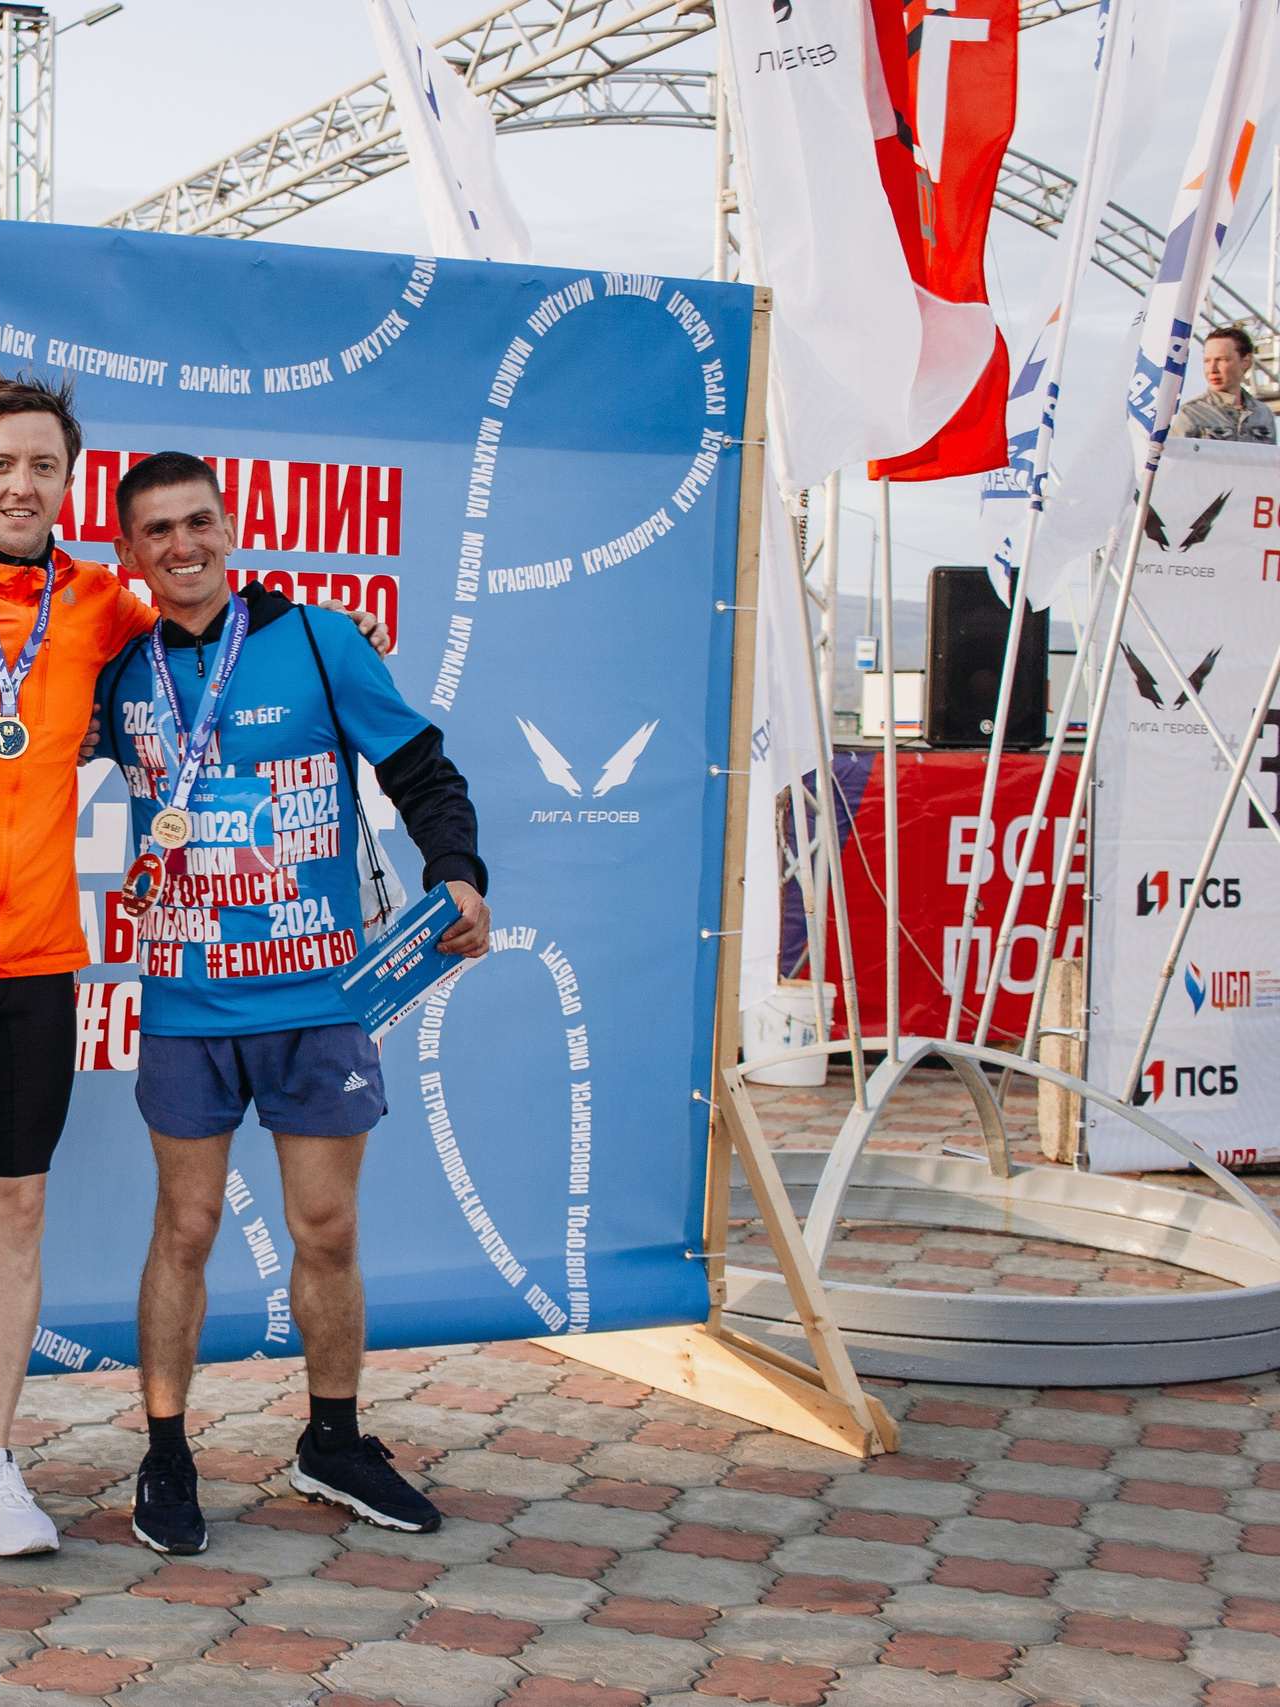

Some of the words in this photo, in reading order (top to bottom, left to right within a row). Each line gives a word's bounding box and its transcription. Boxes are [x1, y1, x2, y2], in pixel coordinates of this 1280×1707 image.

[526, 277, 595, 337] МАГАДАН
[602, 272, 664, 302] ЛИПЕЦК
[47, 339, 168, 387] ЕКАТЕРИНБУРГ
[179, 363, 251, 394] ЗАРАЙСК
[263, 358, 333, 394] ИЖЕВСК
[339, 309, 409, 375] ИРКУТСК
[401, 255, 437, 309] КАЗА
[665, 291, 715, 353] КЫЗЫЛ
[487, 336, 533, 409] МАЙКОП
[702, 358, 726, 415] КУРСК
[465, 416, 503, 518] МАХАЧКАЛА
[671, 427, 724, 513] КУРИЛЬСК
[454, 531, 484, 602] МОСКВА
[582, 508, 675, 575] КРАСНОЯРСК
[487, 557, 573, 594] КРАСНОДАР
[1168, 565, 1215, 577] ГЕРОЕВ
[430, 614, 473, 712] МУРМАНСК
[1128, 722, 1159, 732] ЛИГА
[1163, 723, 1209, 735] ГЕРОЕВ
[529, 811, 572, 823] ЛИГА
[578, 811, 639, 823] ГЕРОЕВ
[269, 896, 335, 938] 2024
[1179, 877, 1241, 908] ПСБ
[205, 929, 358, 979] #ЕДИНСТВО
[389, 927, 431, 969] МЕСТО
[404, 952, 424, 972] КМ
[436, 965, 464, 987] FONBET
[538, 941, 582, 1016] ОРЕНБУРГ
[1211, 971, 1250, 1011] ЦСП
[565, 1024, 590, 1071] ОМСК
[1176, 1065, 1238, 1096] ПСБ
[569, 1080, 590, 1195] НОВОСИБИРСК
[420, 1072, 528, 1288] ПЕТРОПАВЛОВСК-КАМЧАТСКИЙ
[242, 1216, 281, 1280] ТОМСК
[567, 1205, 590, 1288] НОВГОРОД
[265, 1287, 291, 1344] ТВЕРЬ
[524, 1284, 568, 1332] ПСКОВ
